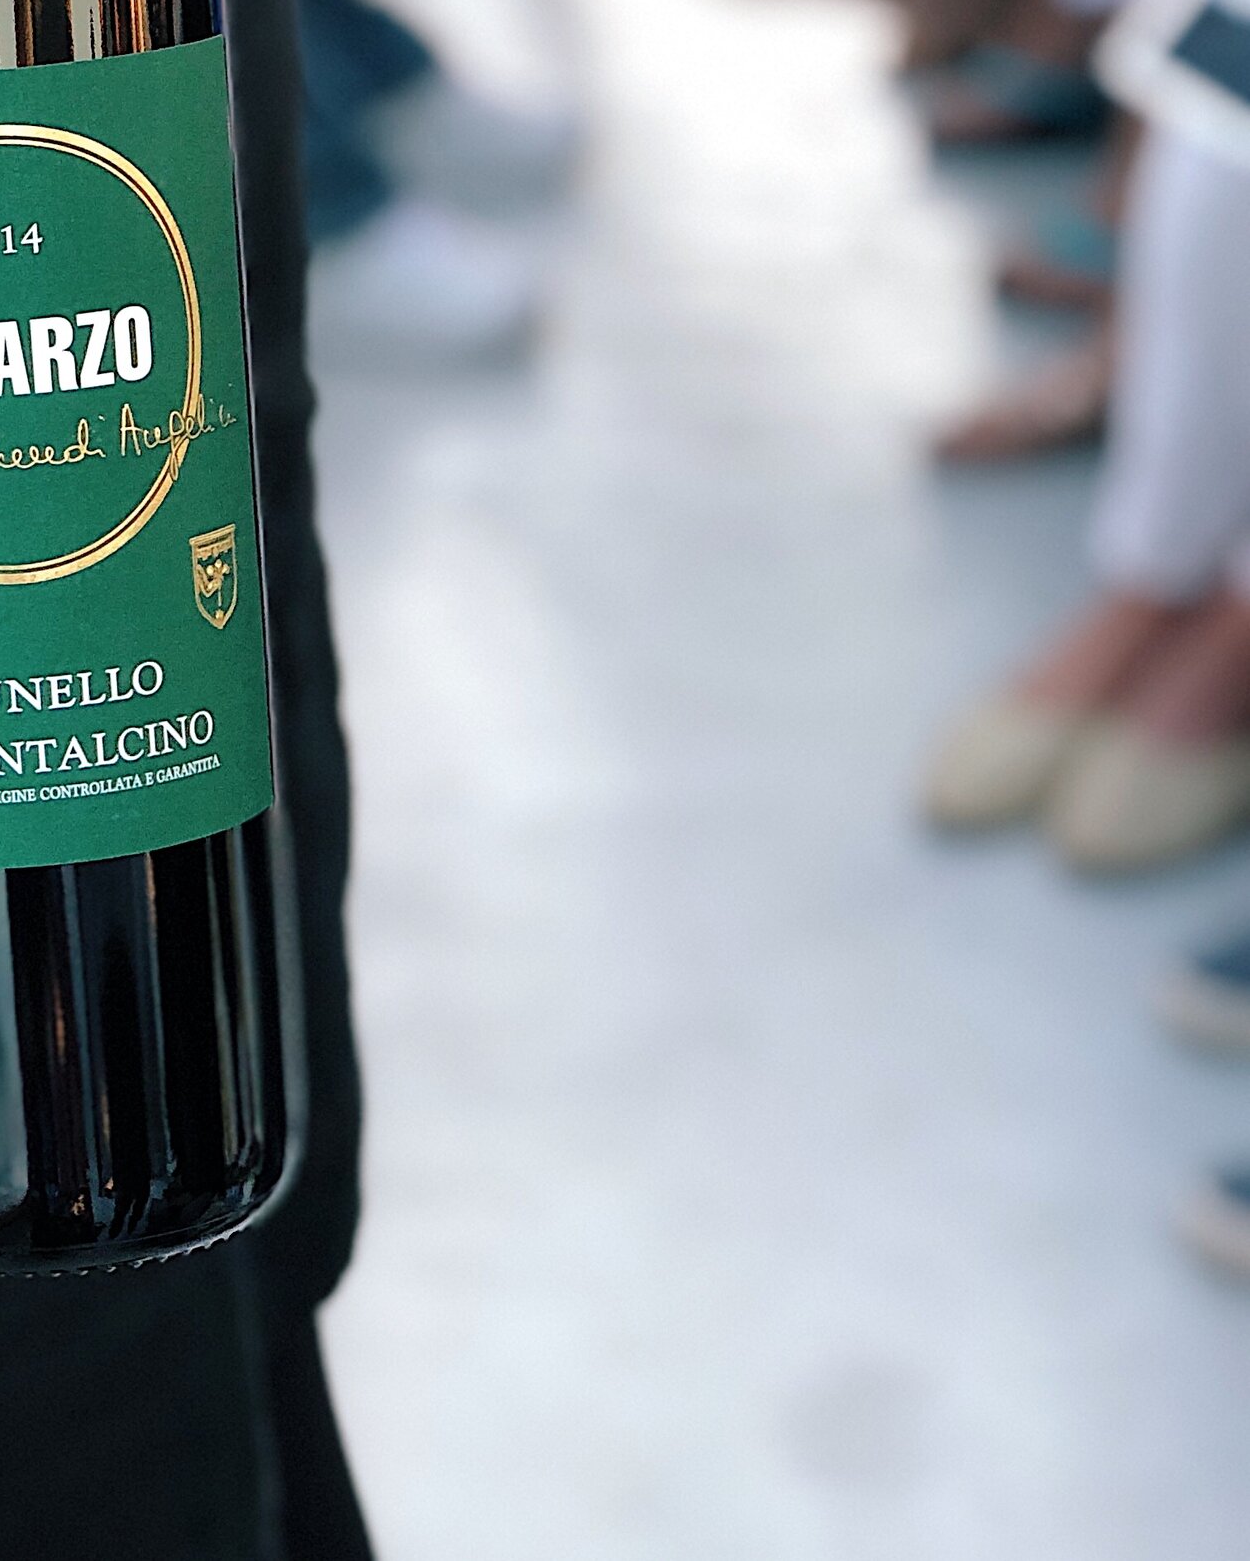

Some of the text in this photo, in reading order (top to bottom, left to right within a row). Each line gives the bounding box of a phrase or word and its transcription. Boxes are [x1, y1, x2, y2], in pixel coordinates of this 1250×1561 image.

[39, 772, 143, 802] CONTROLLATA
[144, 771, 155, 787] E
[156, 753, 222, 784] GARANTITA
